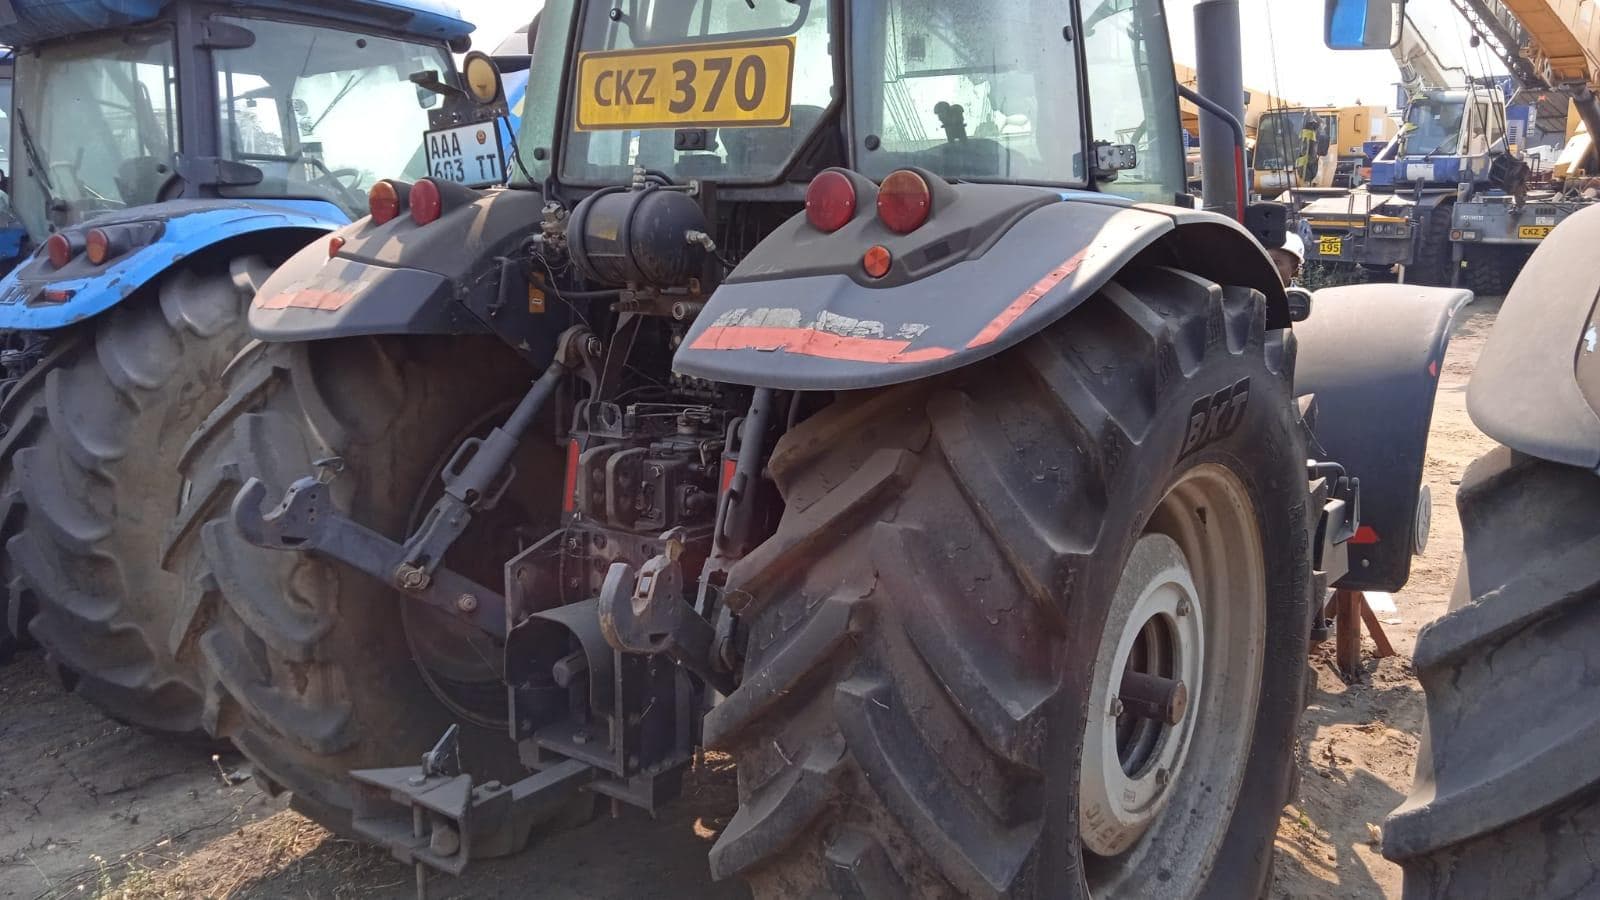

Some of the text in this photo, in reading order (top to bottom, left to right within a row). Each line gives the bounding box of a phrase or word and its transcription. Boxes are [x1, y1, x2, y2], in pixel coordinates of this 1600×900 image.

[594, 54, 765, 113] CKZ 370
[431, 132, 462, 160] AAA
[475, 153, 498, 180] TT
[1522, 228, 1540, 236] CKZ
[1320, 243, 1340, 253] 195
[1182, 390, 1249, 455] BKT
